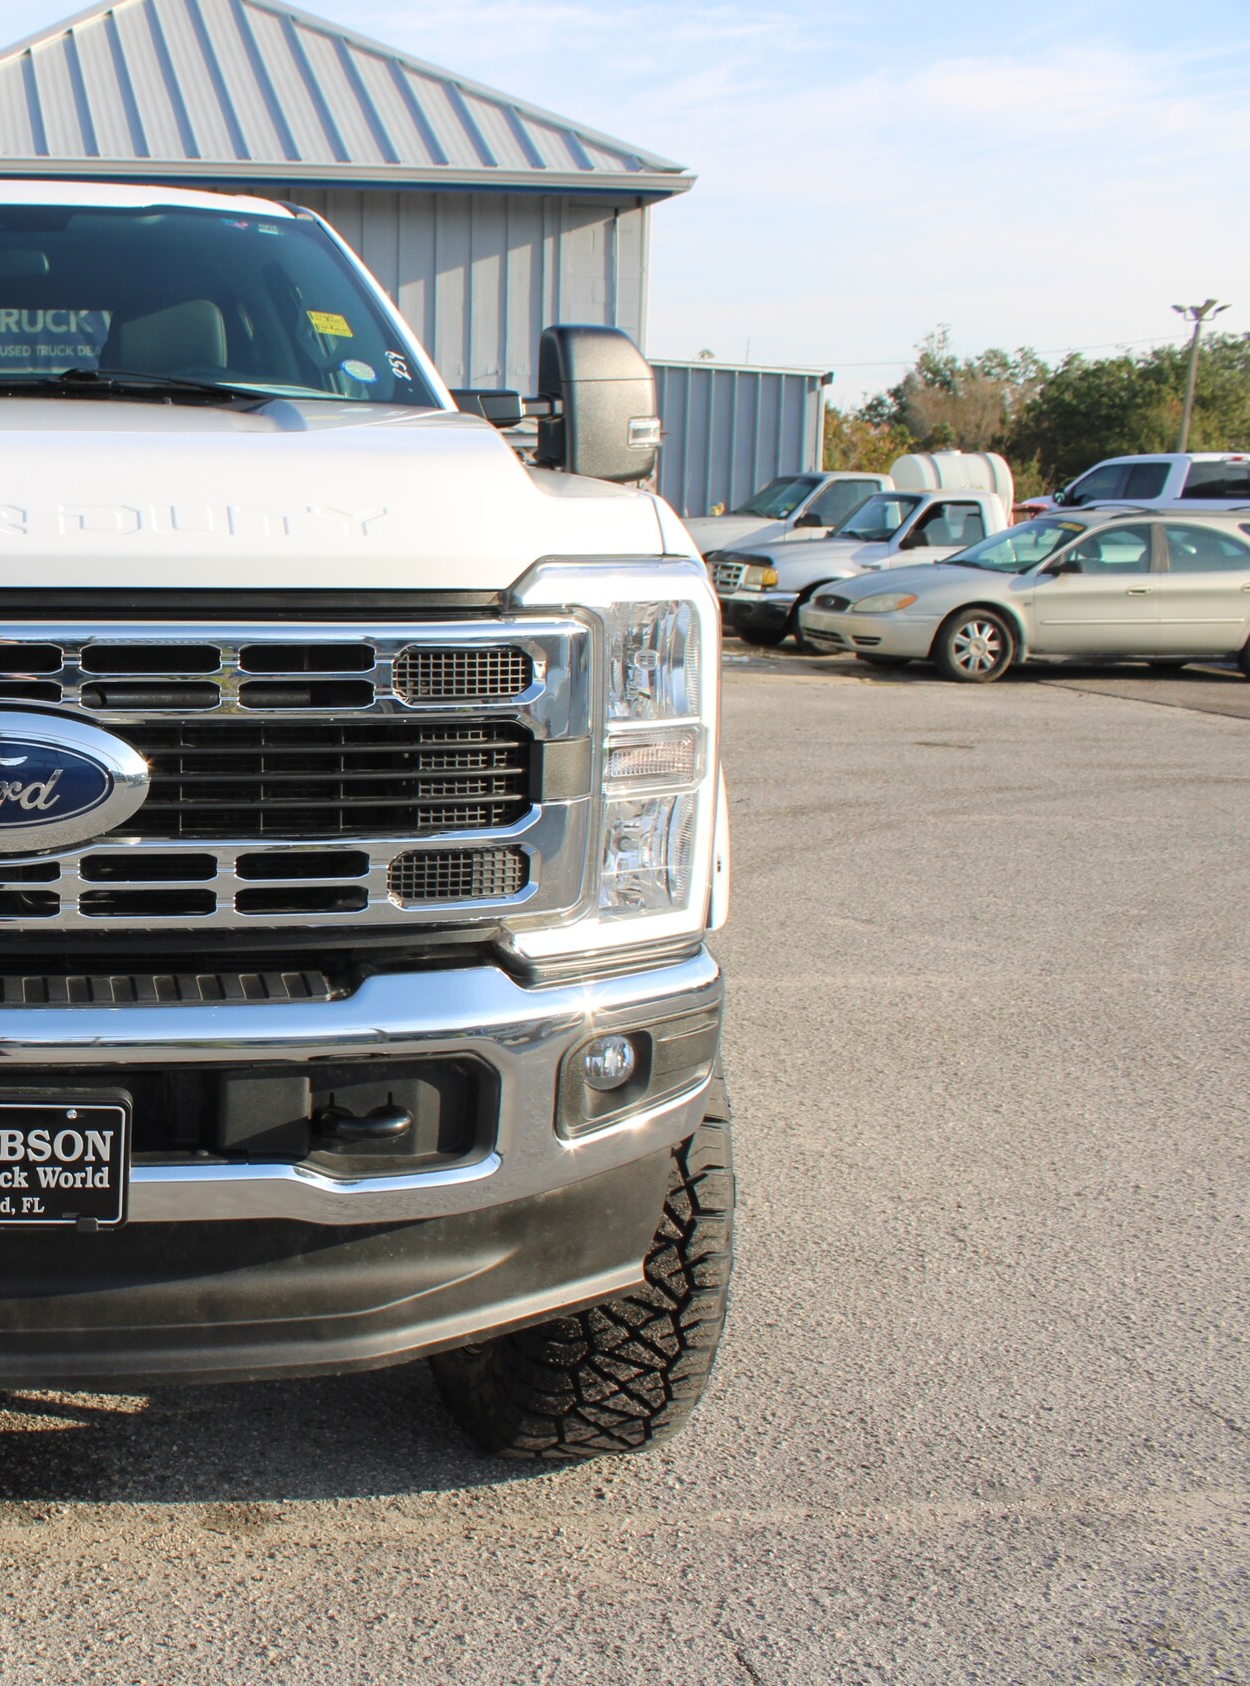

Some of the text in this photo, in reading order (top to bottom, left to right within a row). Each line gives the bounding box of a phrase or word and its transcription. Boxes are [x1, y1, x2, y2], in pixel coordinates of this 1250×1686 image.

[0, 345, 31, 356] USED
[35, 345, 74, 356] TRUCK
[57, 503, 388, 536] DUTY
[36, 1166, 110, 1189] World
[21, 1197, 45, 1213] FL
